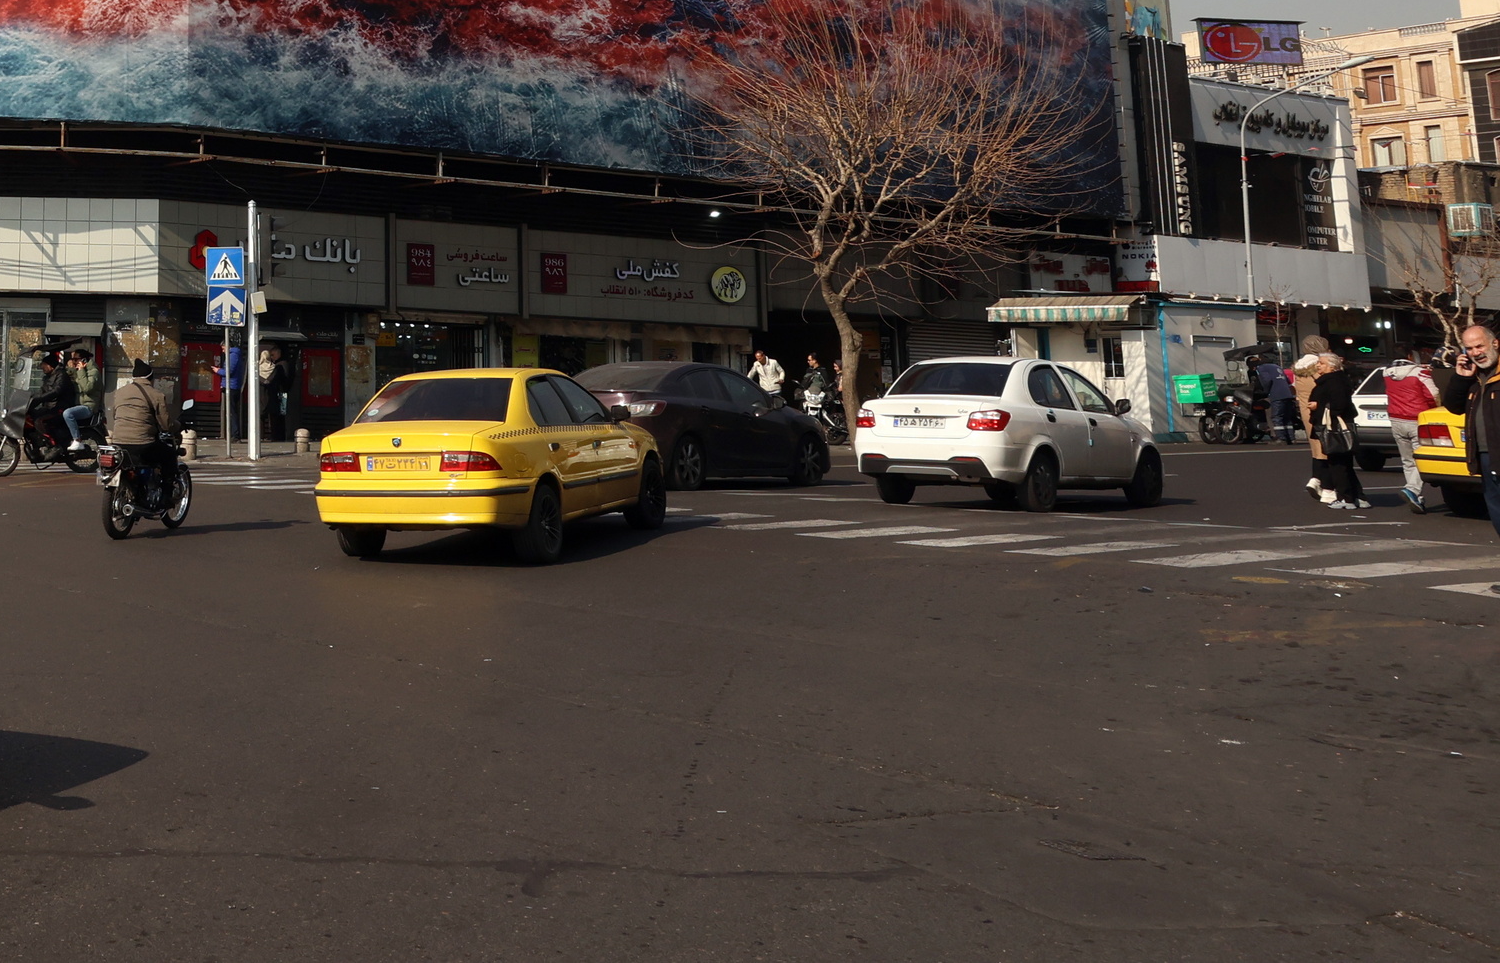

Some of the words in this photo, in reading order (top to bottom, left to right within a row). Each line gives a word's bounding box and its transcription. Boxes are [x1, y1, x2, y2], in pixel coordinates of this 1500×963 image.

[1262, 37, 1300, 52] LG
[1172, 141, 1193, 236] SAMSUNG
[411, 248, 432, 257] 984
[545, 258, 564, 267] 986
[616, 260, 642, 280] ملی
[643, 259, 680, 282] کفش
[458, 267, 510, 286] ساعتی
[601, 285, 627, 297] انقلاب
